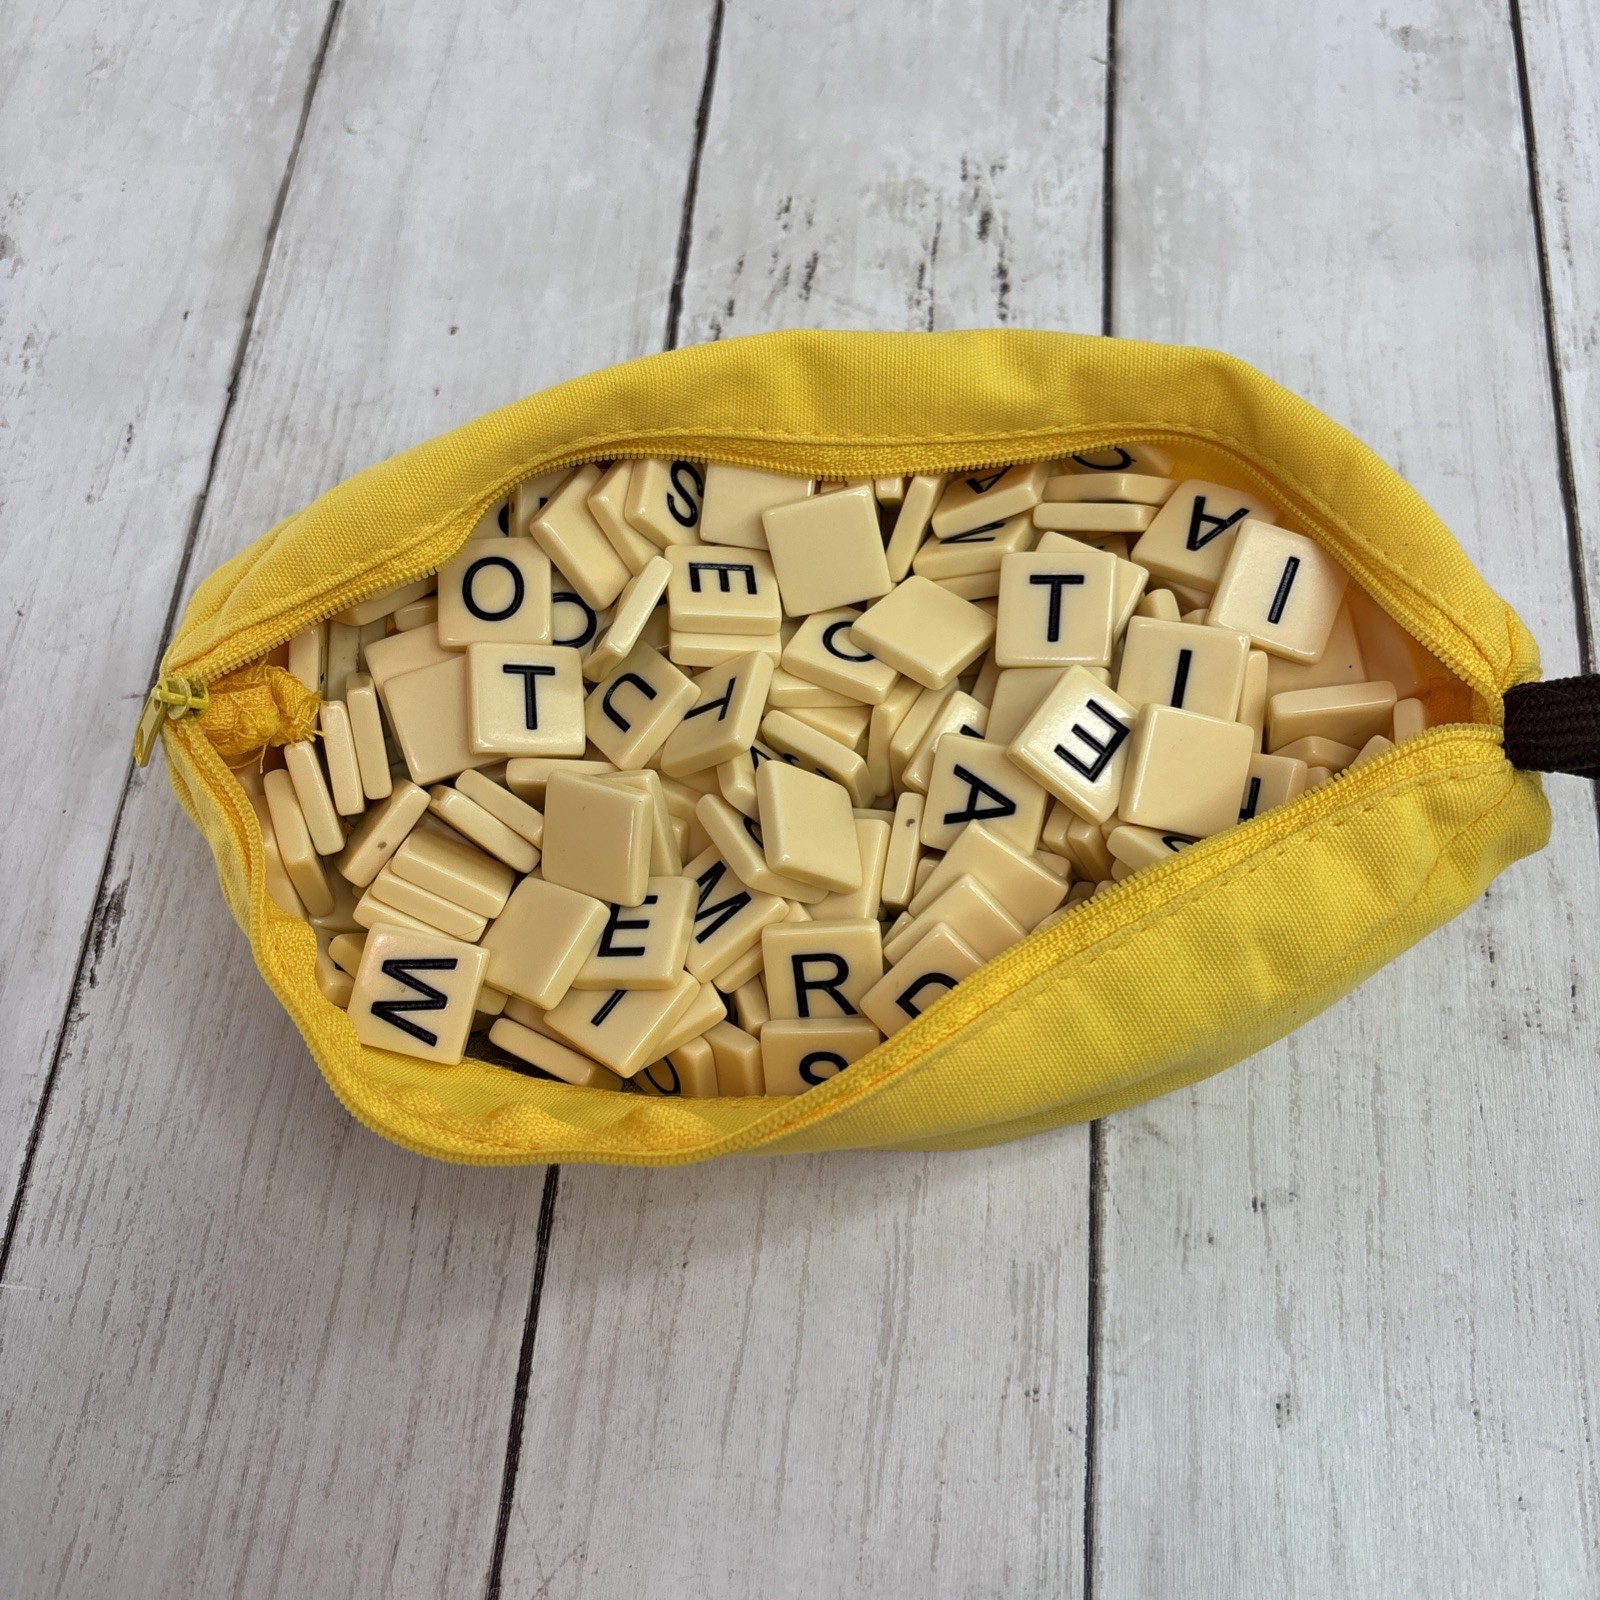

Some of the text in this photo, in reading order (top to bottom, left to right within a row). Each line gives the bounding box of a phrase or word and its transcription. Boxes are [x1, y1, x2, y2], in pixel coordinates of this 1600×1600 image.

[665, 460, 704, 529] S
[1185, 495, 1250, 552] A
[462, 556, 525, 622] O
[689, 562, 758, 595] E
[1029, 574, 1085, 643] T
[1267, 556, 1300, 625] I
[503, 663, 555, 730] T
[602, 672, 658, 733] U
[683, 676, 736, 721] T
[1053, 699, 1131, 783] E
[943, 763, 1017, 825] A
[597, 895, 658, 957] E
[791, 952, 859, 1018] R
